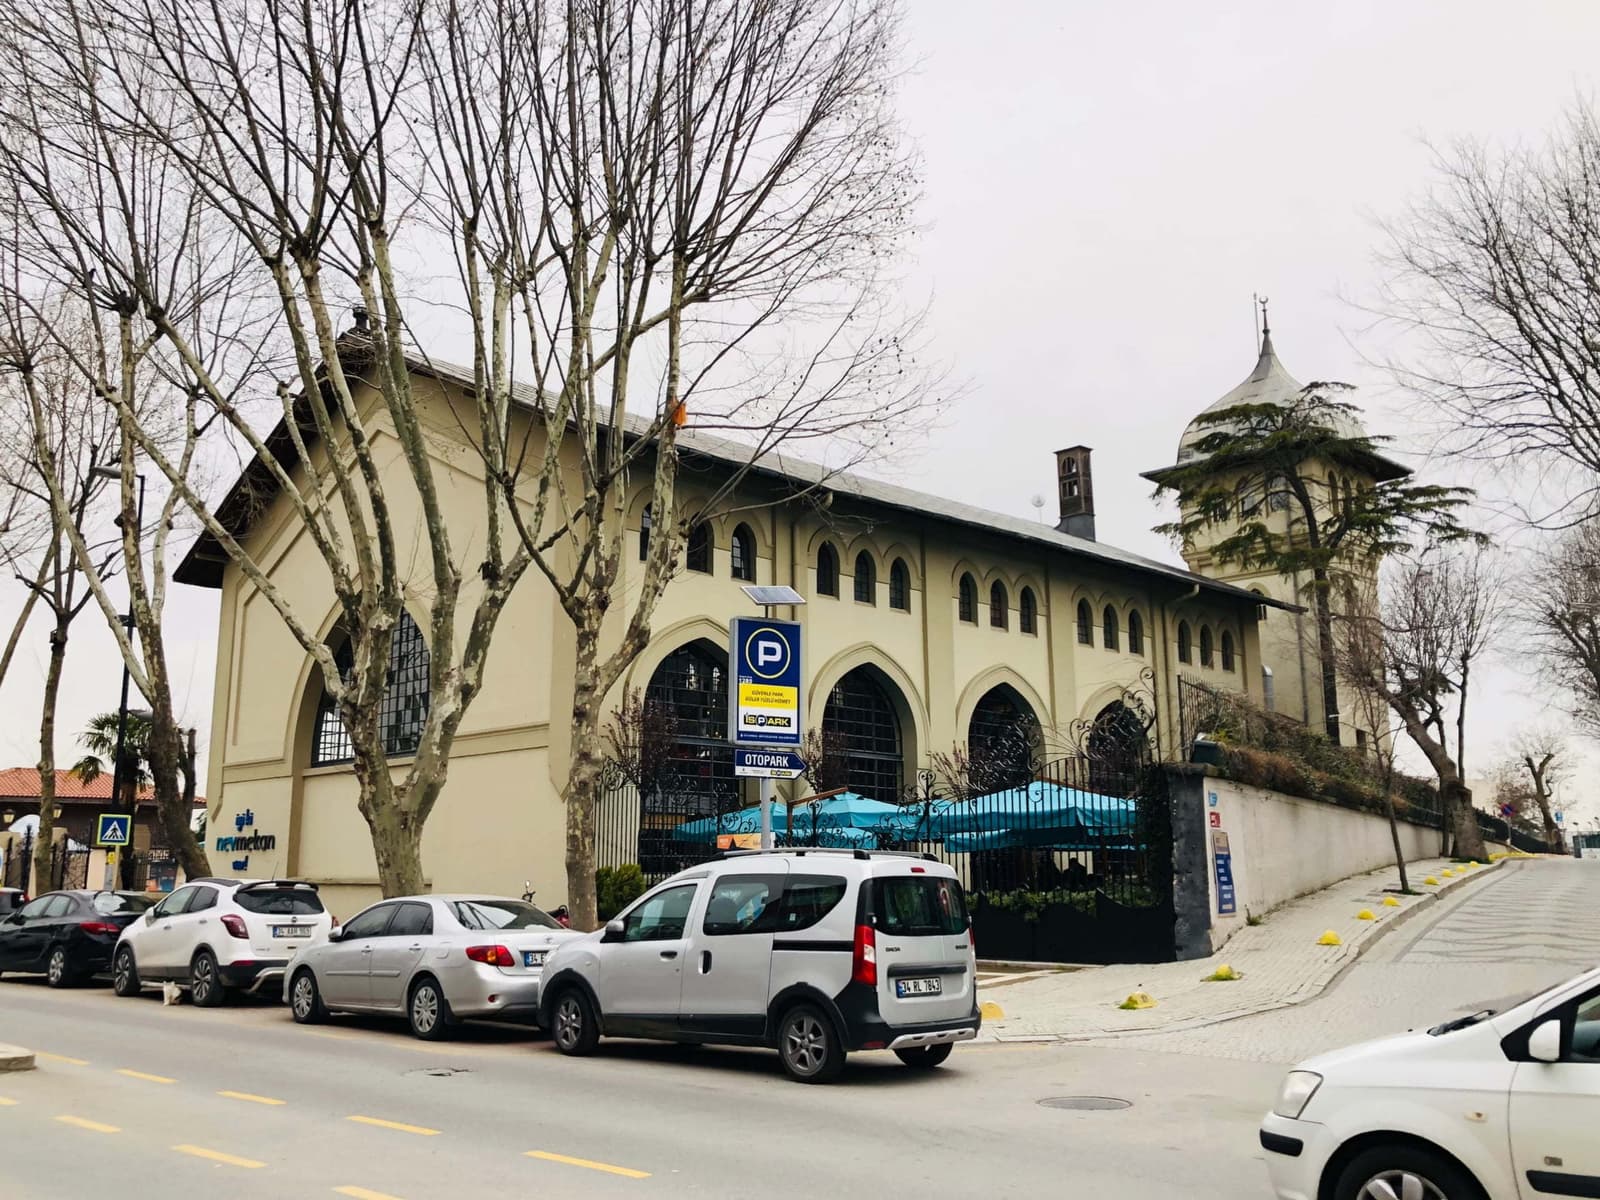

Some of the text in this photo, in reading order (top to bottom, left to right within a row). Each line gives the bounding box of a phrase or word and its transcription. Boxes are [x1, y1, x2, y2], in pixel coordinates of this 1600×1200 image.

[758, 640, 781, 666] P
[744, 754, 789, 767] OTOPARK
[216, 829, 275, 852] nevmekan
[903, 979, 940, 992] 34 RL 7843
